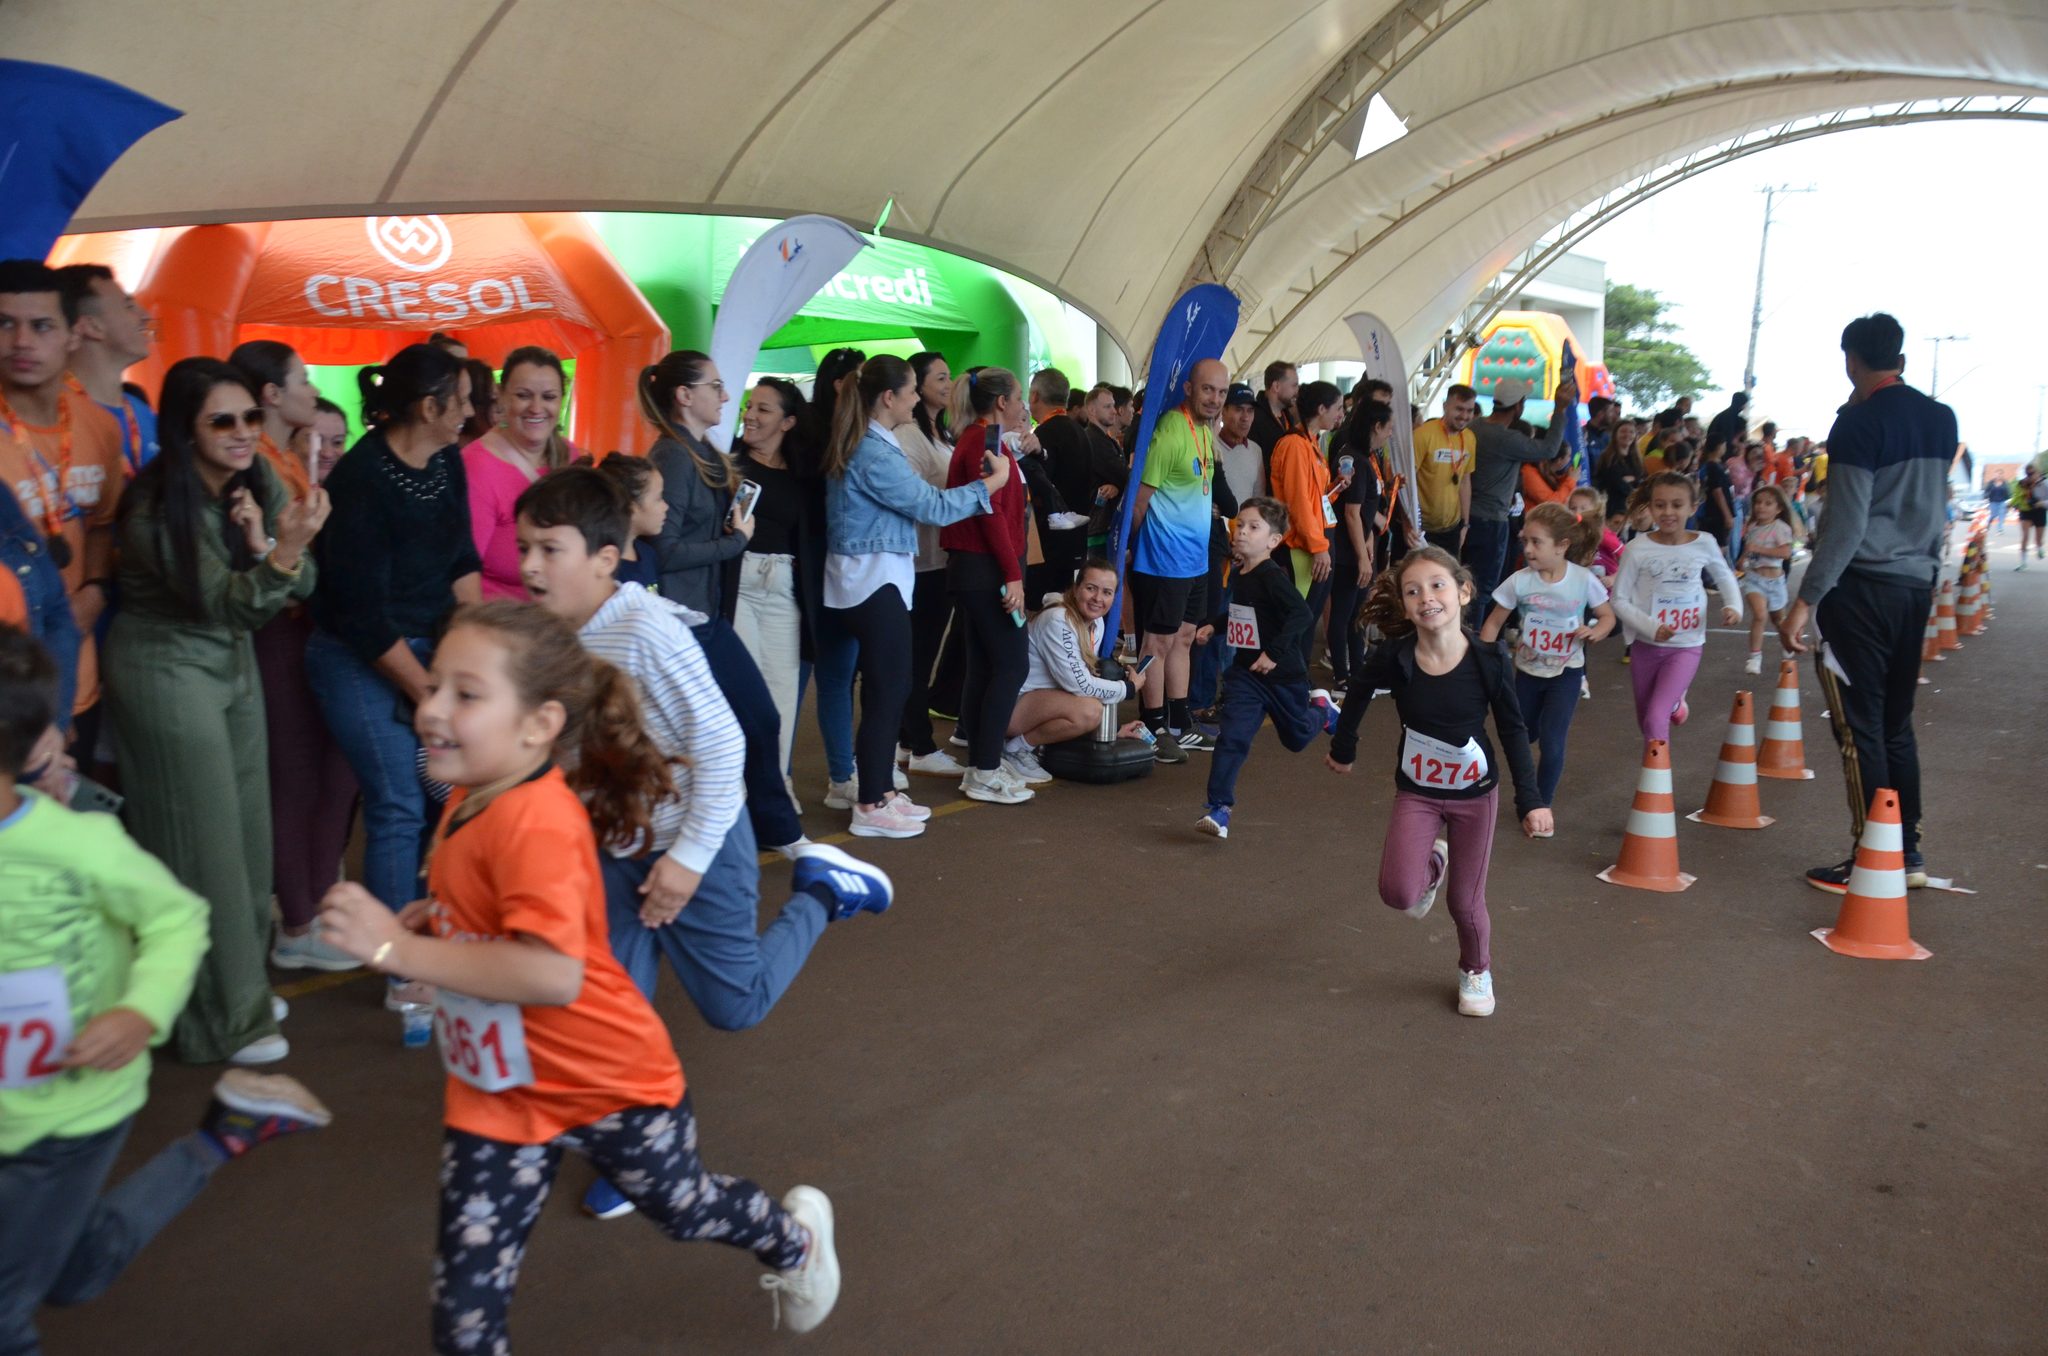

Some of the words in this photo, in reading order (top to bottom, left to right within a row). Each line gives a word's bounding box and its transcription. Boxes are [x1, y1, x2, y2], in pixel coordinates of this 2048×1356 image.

[304, 274, 553, 320] CRESOL
[1657, 607, 1700, 631] 1365
[1228, 621, 1256, 646] 382
[1529, 628, 1575, 653] 1347
[1410, 752, 1478, 785] 1274
